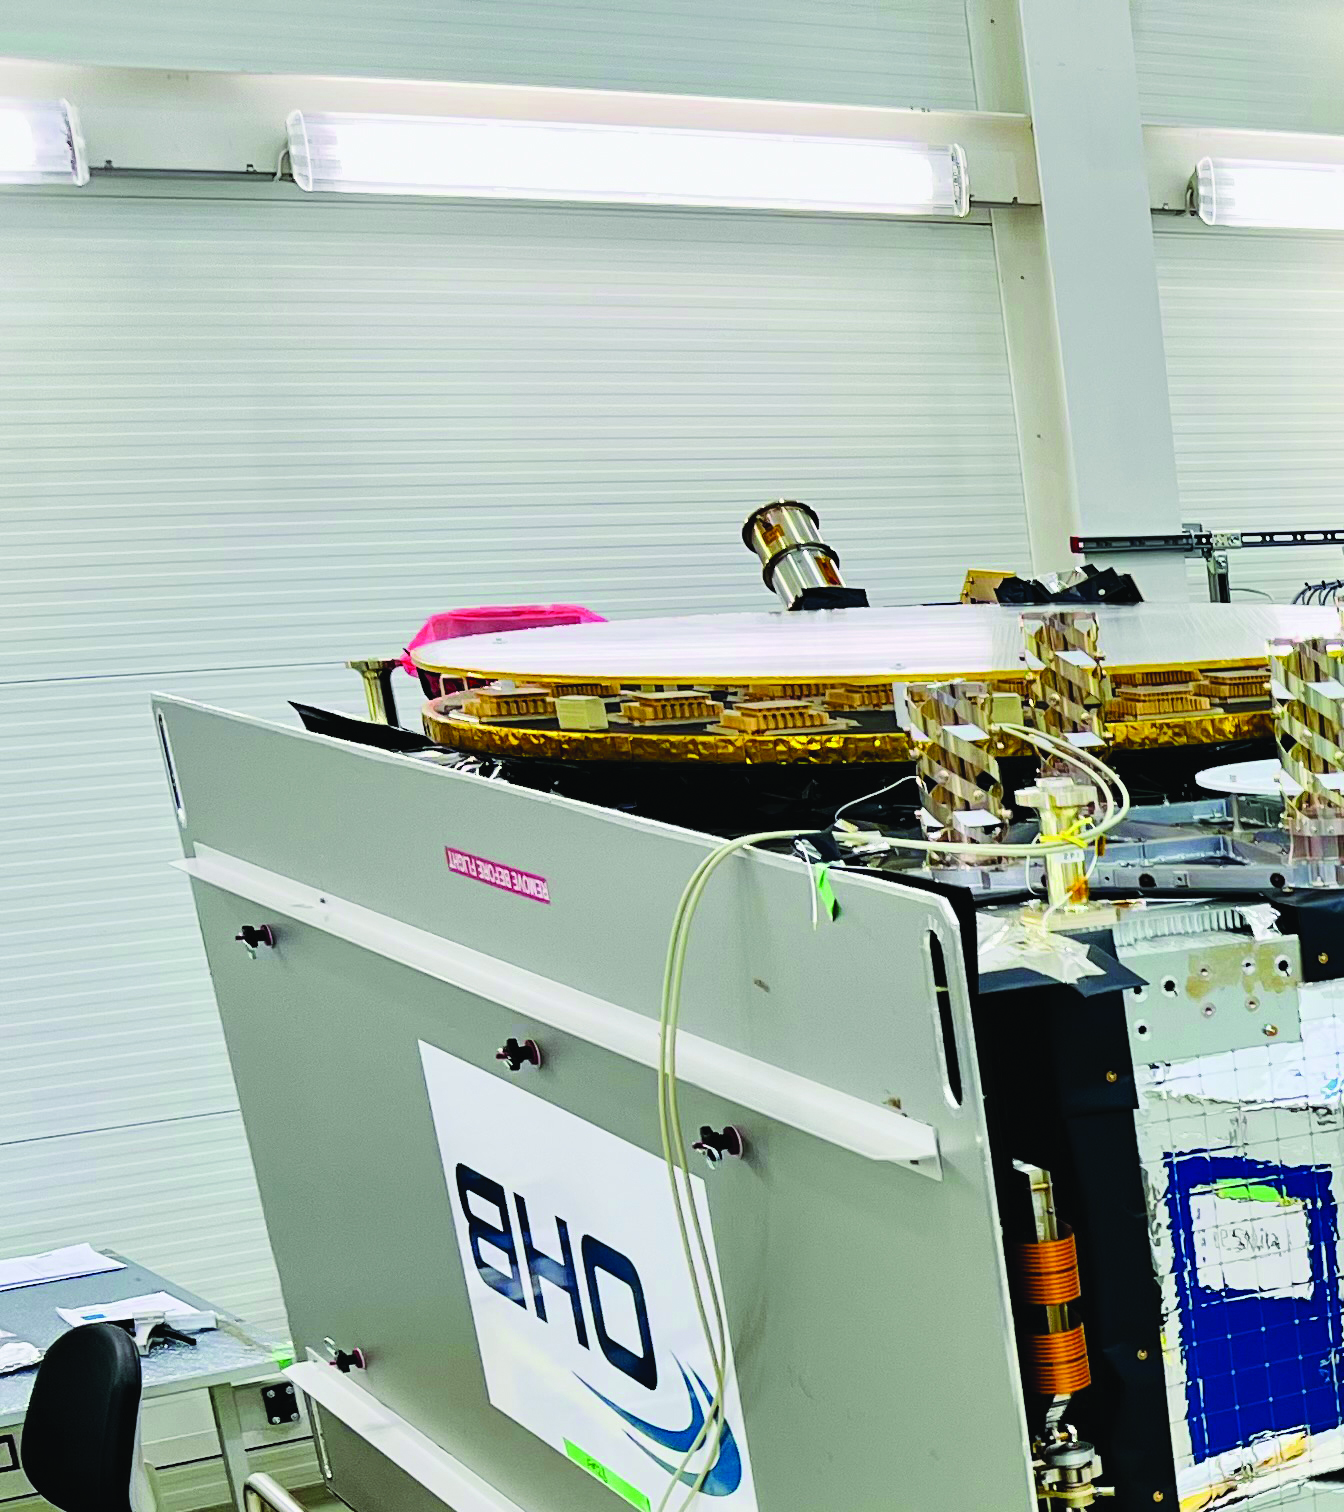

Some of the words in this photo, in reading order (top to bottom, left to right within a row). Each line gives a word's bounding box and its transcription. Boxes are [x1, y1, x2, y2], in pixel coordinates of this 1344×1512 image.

[449, 852, 477, 878] FLIGHT
[478, 860, 513, 889] BEFORE
[512, 871, 549, 901] REMOVE
[456, 1162, 658, 1391] OHB
